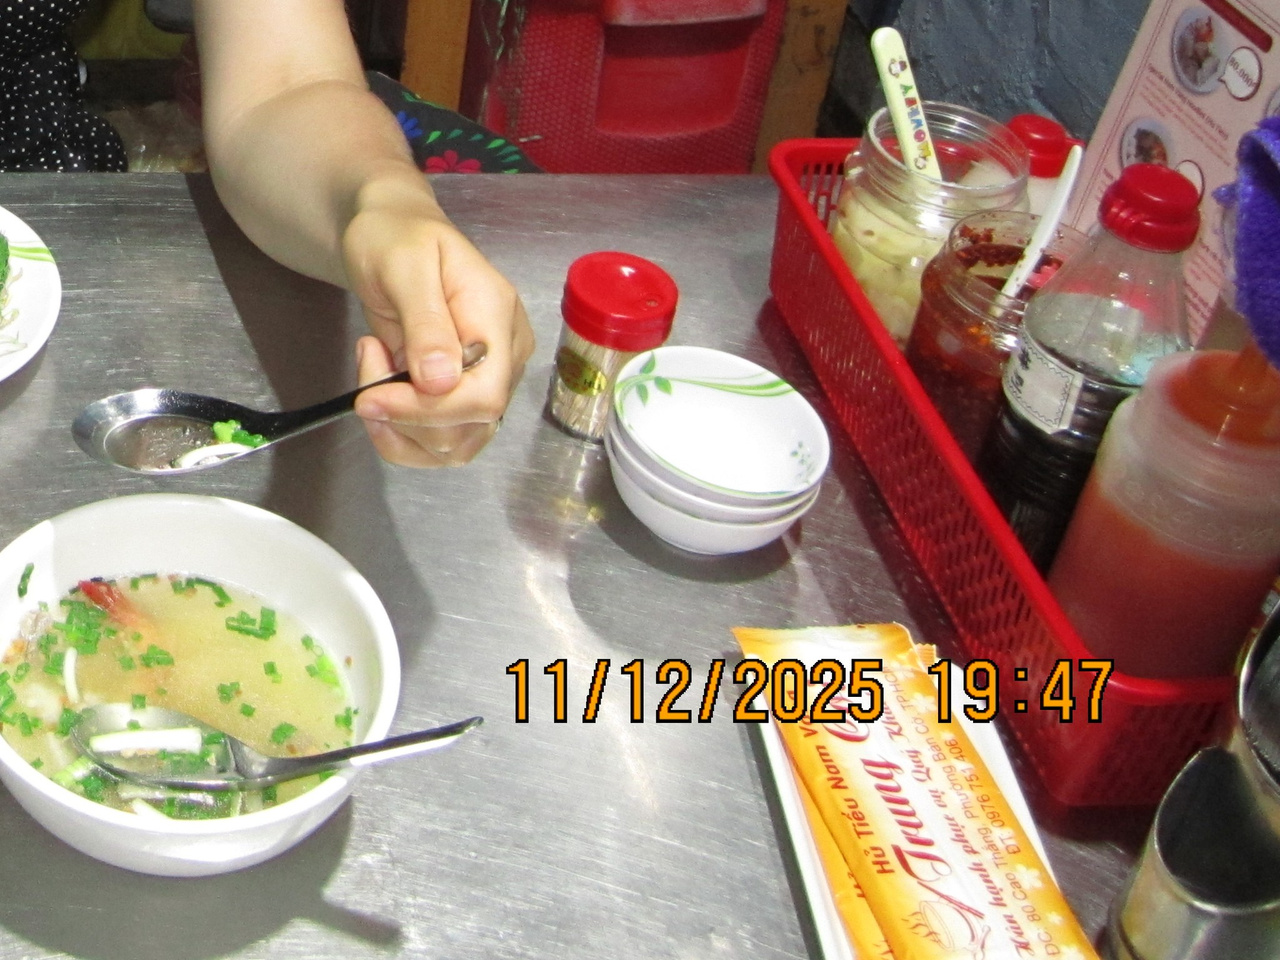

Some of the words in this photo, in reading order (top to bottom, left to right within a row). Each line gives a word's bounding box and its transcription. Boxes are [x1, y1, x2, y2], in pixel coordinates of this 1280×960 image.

[944, 735, 968, 764] 406
[812, 744, 850, 791] Nam
[959, 761, 984, 792] 751
[834, 795, 875, 842] Tiếu
[859, 754, 953, 884] Trung
[976, 793, 1005, 829] 0976
[861, 842, 896, 876] Hủ
[966, 859, 1008, 908] hạnh
[1003, 871, 1028, 901] Cao
[1020, 901, 1041, 924] 80
